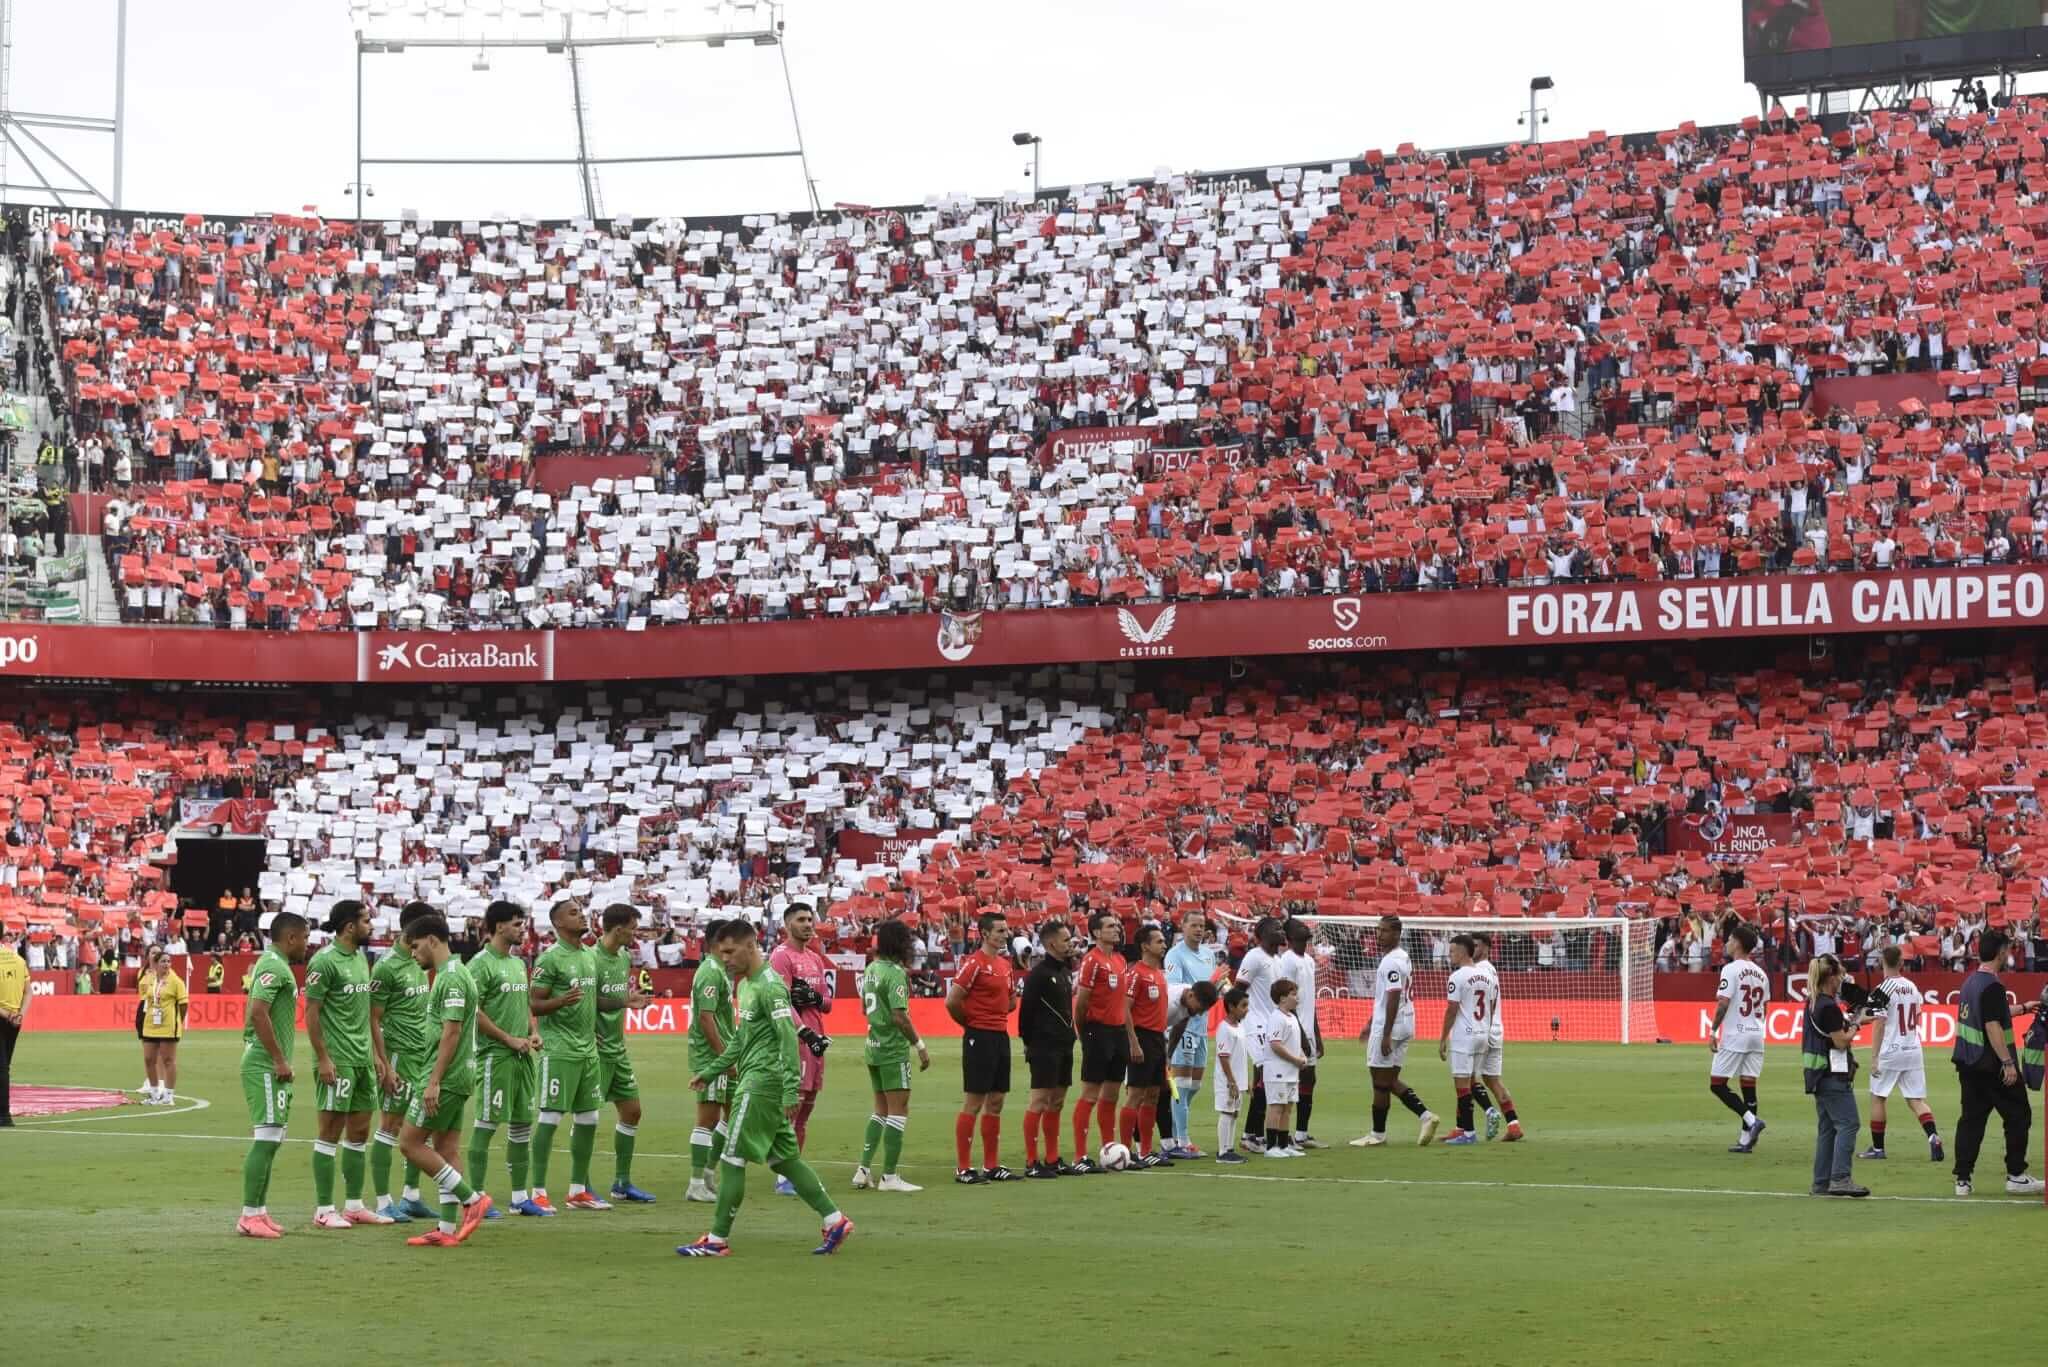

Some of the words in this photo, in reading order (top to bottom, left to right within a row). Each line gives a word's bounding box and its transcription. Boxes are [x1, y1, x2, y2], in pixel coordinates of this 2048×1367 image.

[1507, 590, 1642, 636] FORZA
[1657, 581, 1833, 631] SEVILLA
[1851, 572, 2045, 623] CAMPEO
[414, 642, 538, 668] CaixaBank
[1119, 645, 1175, 657] CASTORE
[1473, 989, 1485, 1021] 3
[1739, 984, 1764, 1019] 32
[1897, 1003, 1918, 1036] 14
[1181, 1035, 1194, 1050] 13
[335, 1078, 351, 1099] 12
[550, 1078, 560, 1097] 6
[277, 1089, 287, 1110] 8
[493, 1089, 504, 1110] 4
